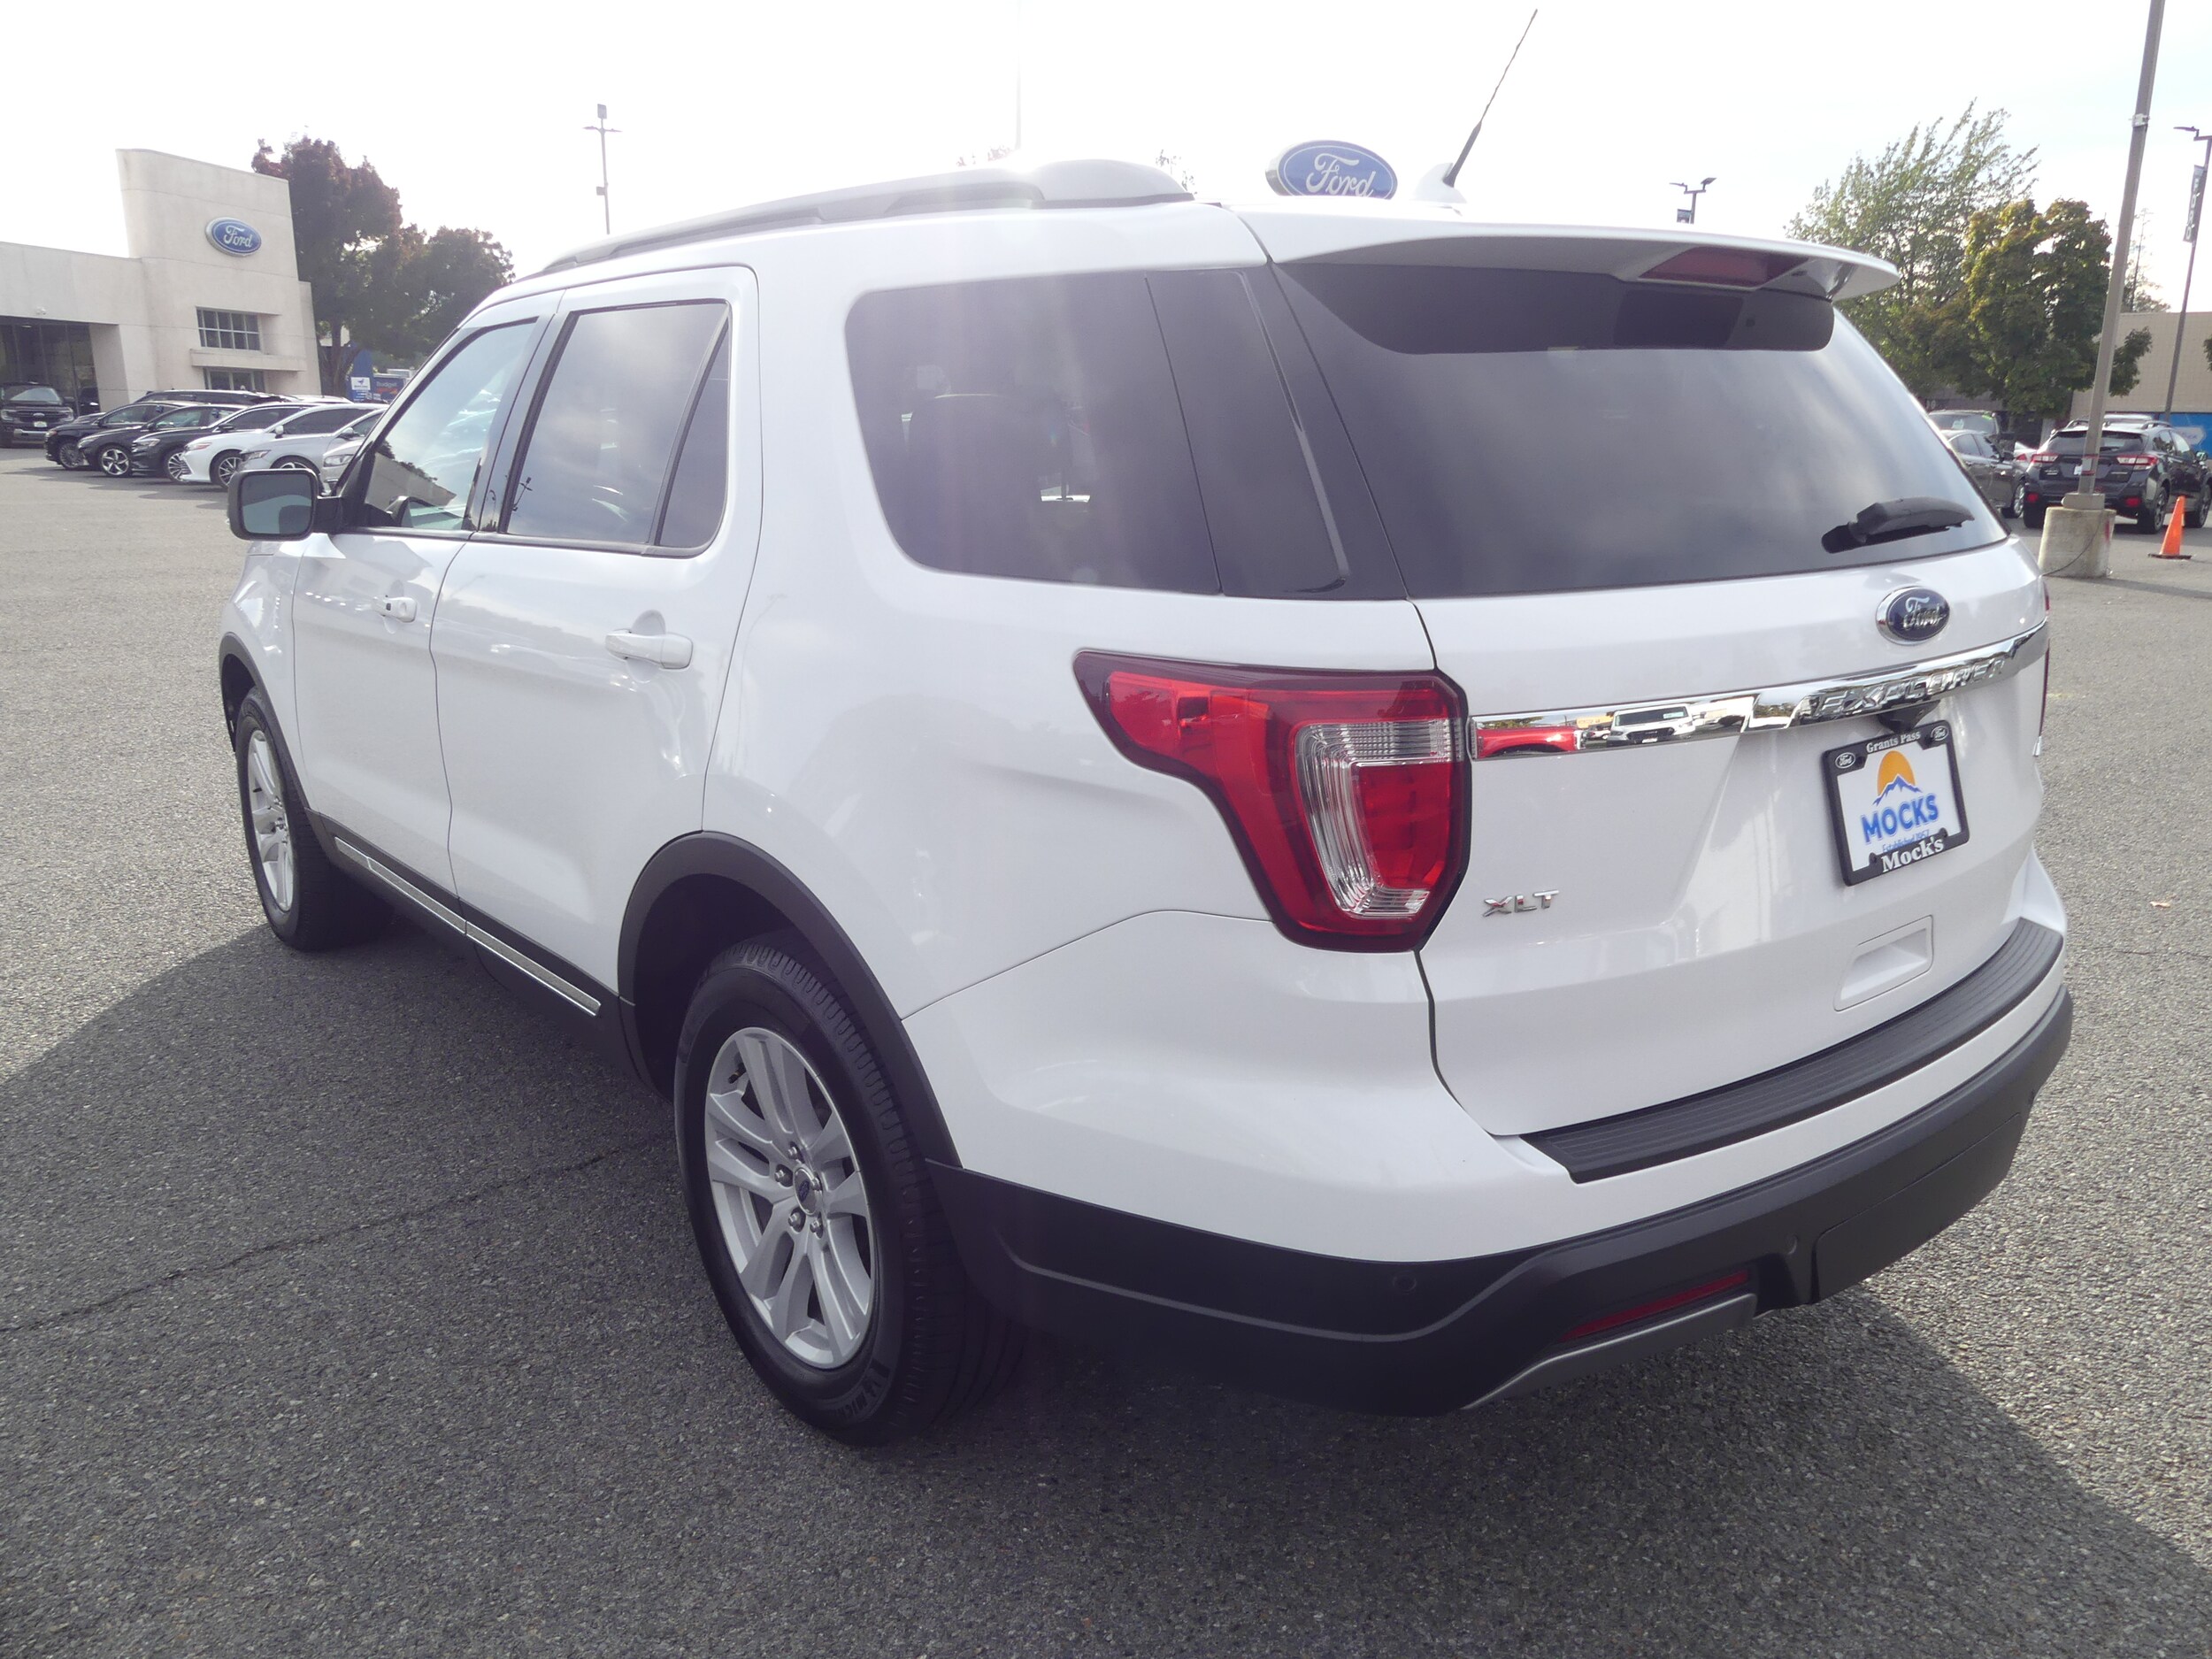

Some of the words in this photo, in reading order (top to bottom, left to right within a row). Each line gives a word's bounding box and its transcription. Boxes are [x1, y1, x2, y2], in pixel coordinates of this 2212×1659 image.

[1306, 153, 1377, 197] Ford
[223, 225, 254, 248] Ford
[1902, 596, 1946, 631] Ford
[1866, 737, 1899, 753] Grants
[1901, 731, 1921, 744] Pass
[1861, 793, 1939, 844] MOCKS
[1880, 836, 1944, 872] Mock's
[1482, 889, 1560, 918] XLT
